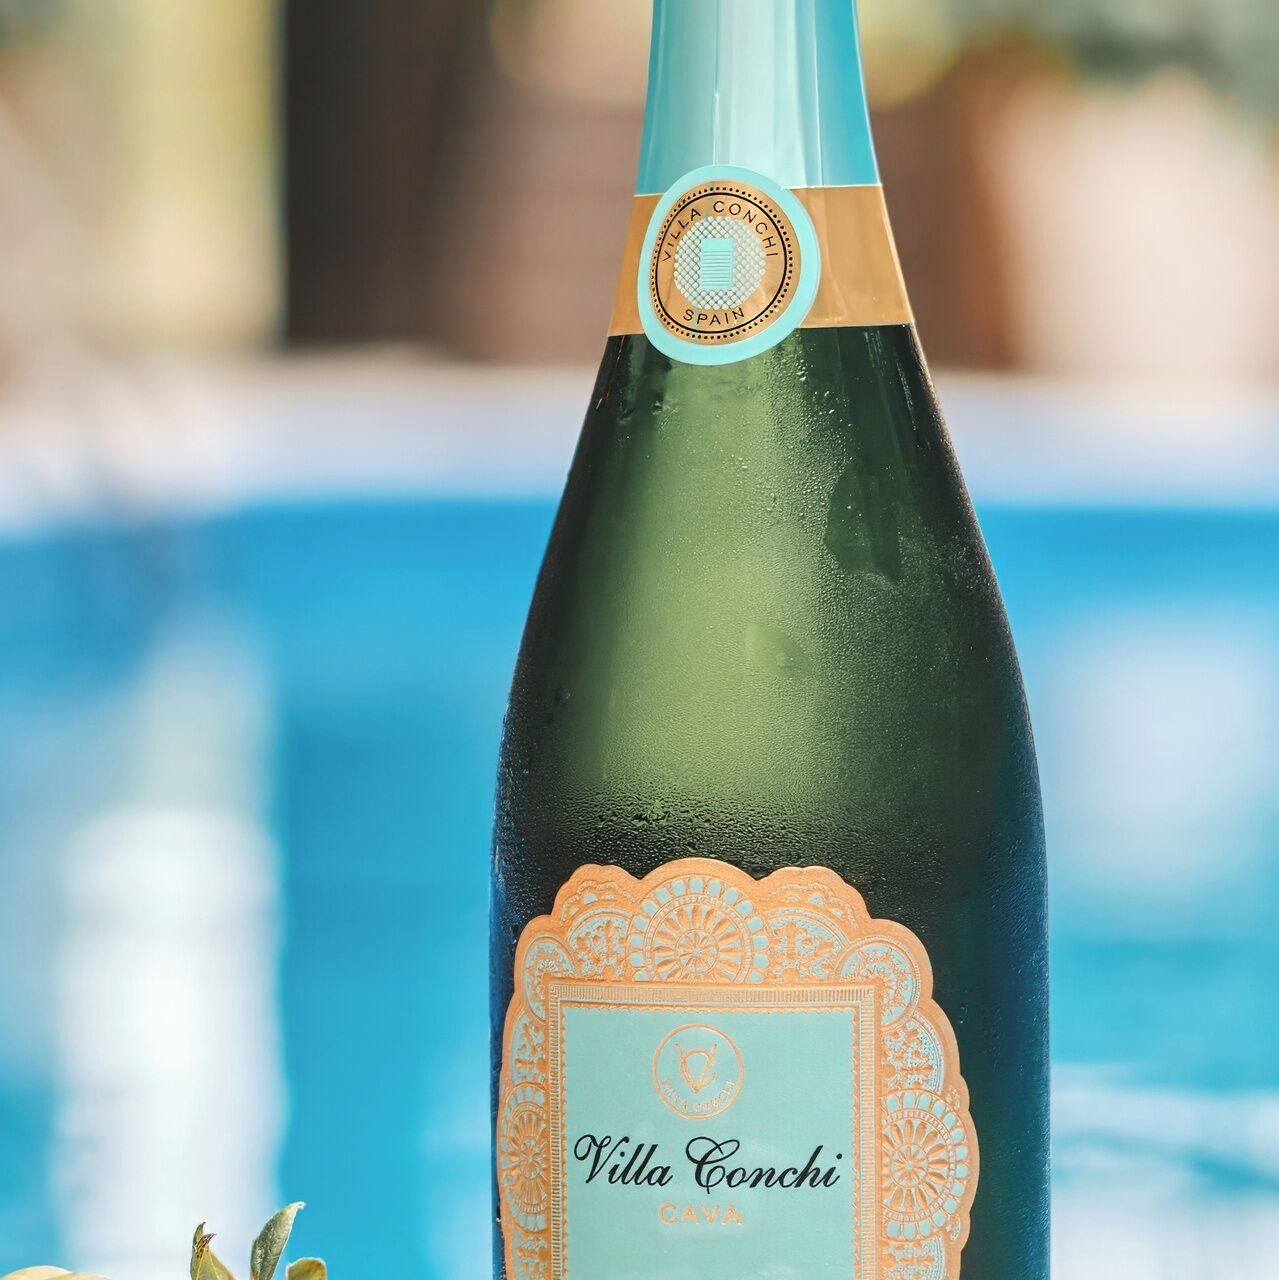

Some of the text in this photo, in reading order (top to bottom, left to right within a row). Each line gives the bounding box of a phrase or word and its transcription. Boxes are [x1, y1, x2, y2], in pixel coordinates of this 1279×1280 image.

[661, 200, 779, 262] VILLA CONCHI
[683, 307, 745, 327] SPAIN
[573, 1134, 844, 1195] Villa Conchi
[657, 1202, 743, 1225] CAVA
